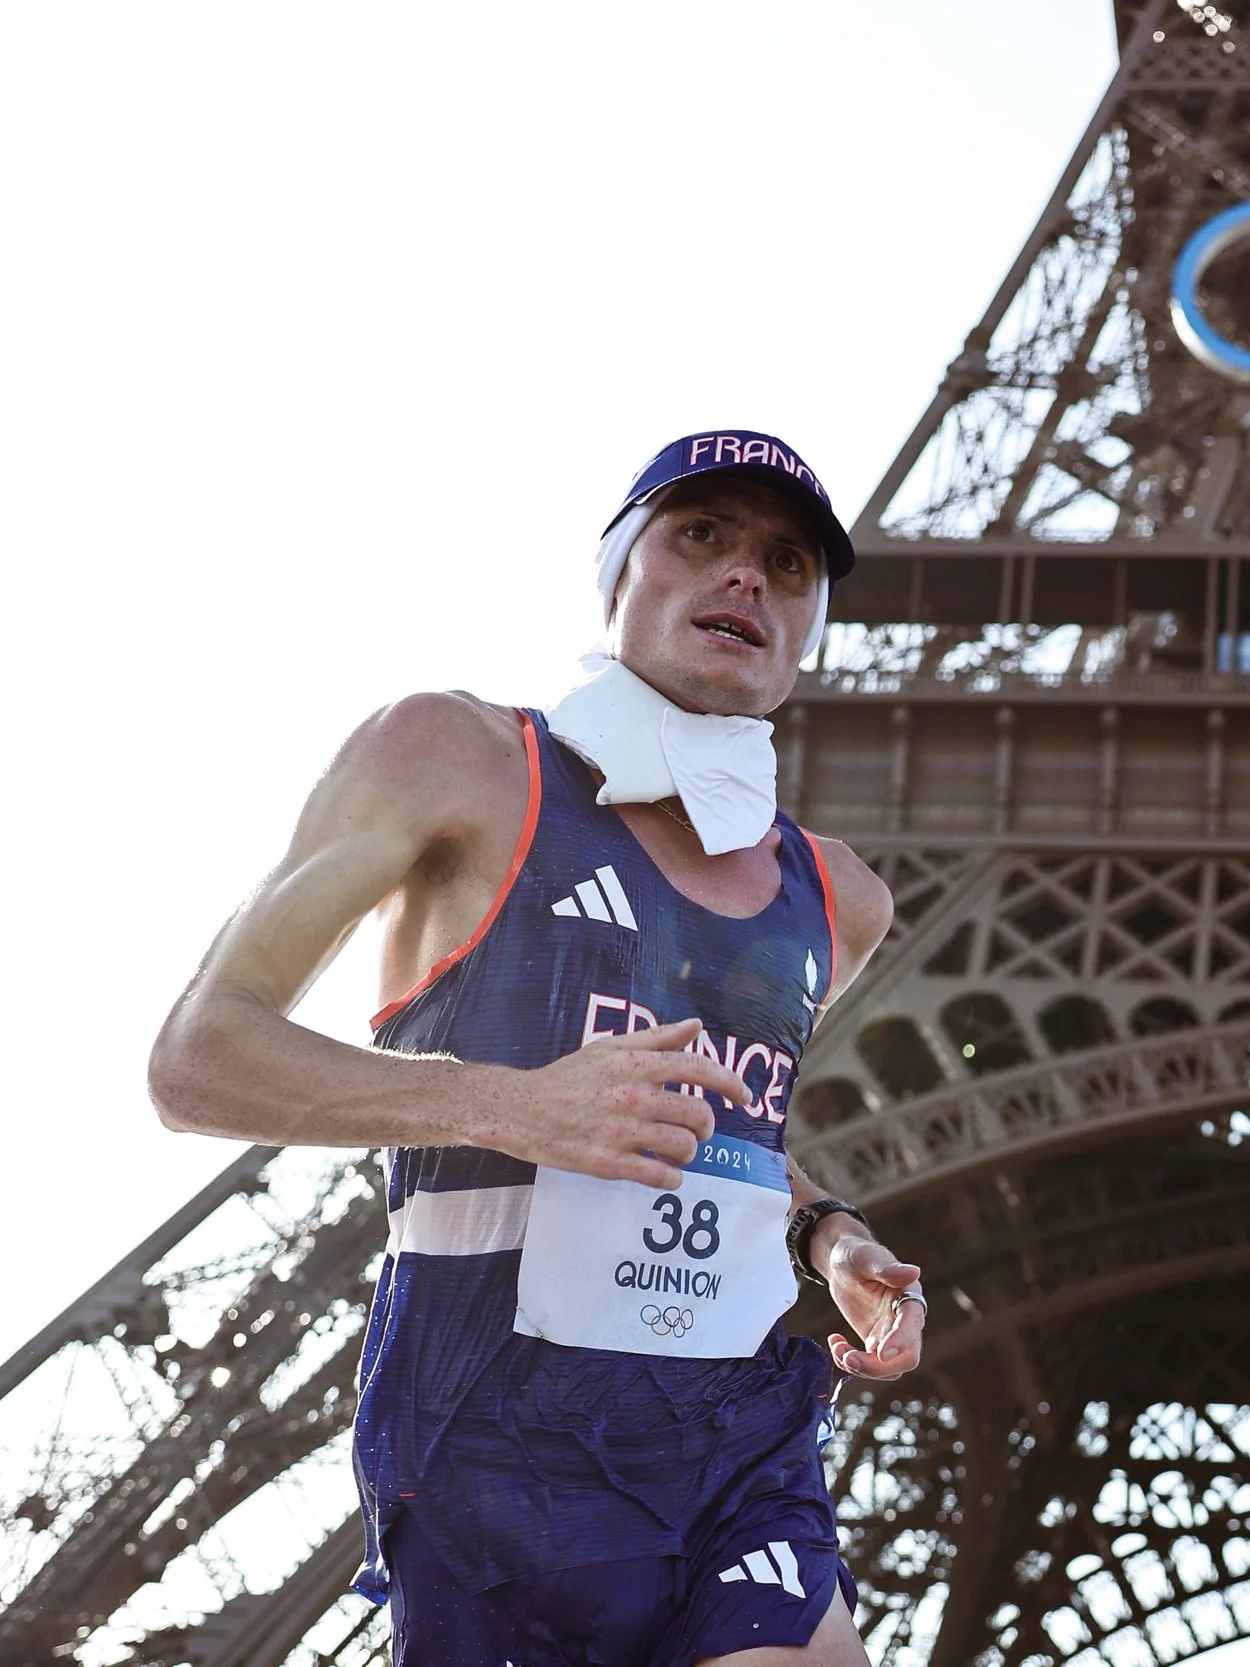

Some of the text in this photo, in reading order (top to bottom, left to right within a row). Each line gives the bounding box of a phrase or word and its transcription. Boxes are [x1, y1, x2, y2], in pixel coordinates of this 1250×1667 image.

[704, 1145, 751, 1171] 2024
[642, 1193, 721, 1259] 38
[614, 1260, 722, 1300] QUINION
